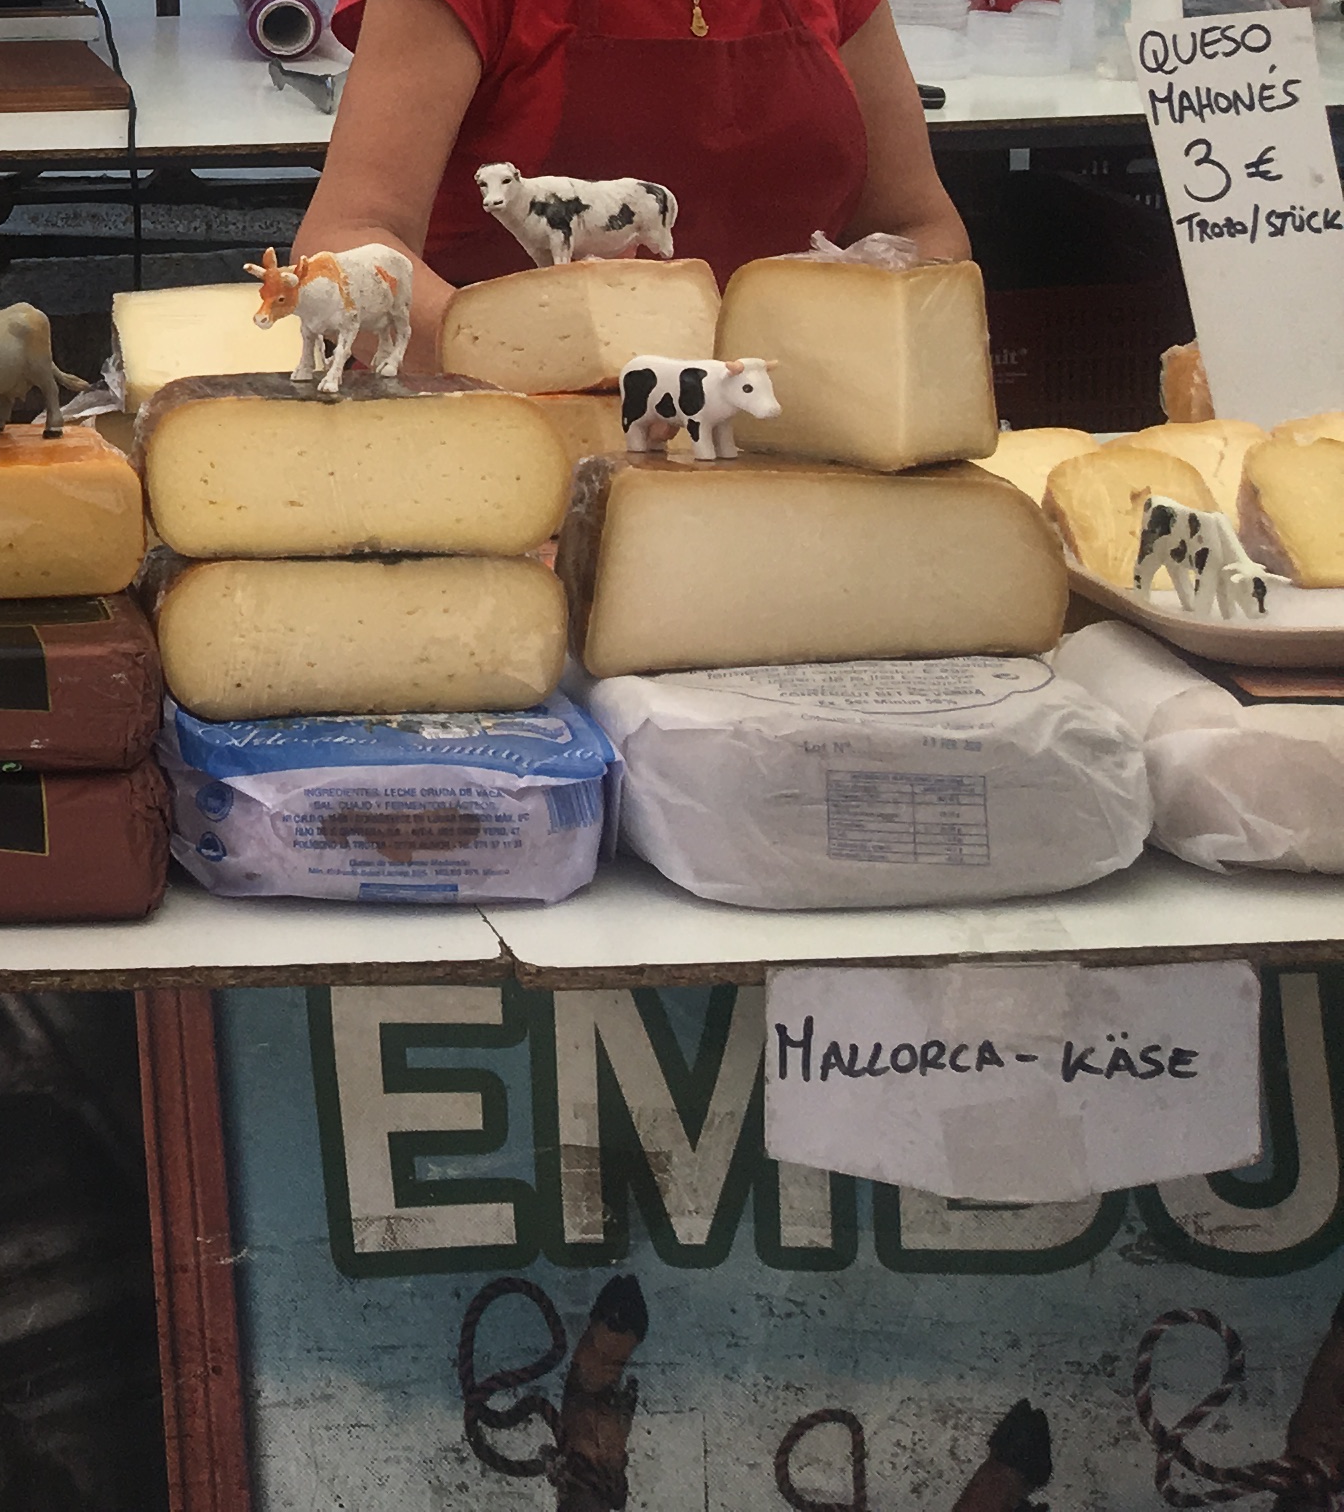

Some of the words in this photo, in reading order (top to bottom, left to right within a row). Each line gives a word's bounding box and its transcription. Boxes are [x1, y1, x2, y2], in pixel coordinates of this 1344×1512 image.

[1139, 23, 1272, 75] QUESO
[1148, 64, 1302, 126] MAHONÉS
[1184, 138, 1231, 202] 3
[1244, 146, 1283, 181] €
[1062, 1031, 1199, 1083] KÄSE
